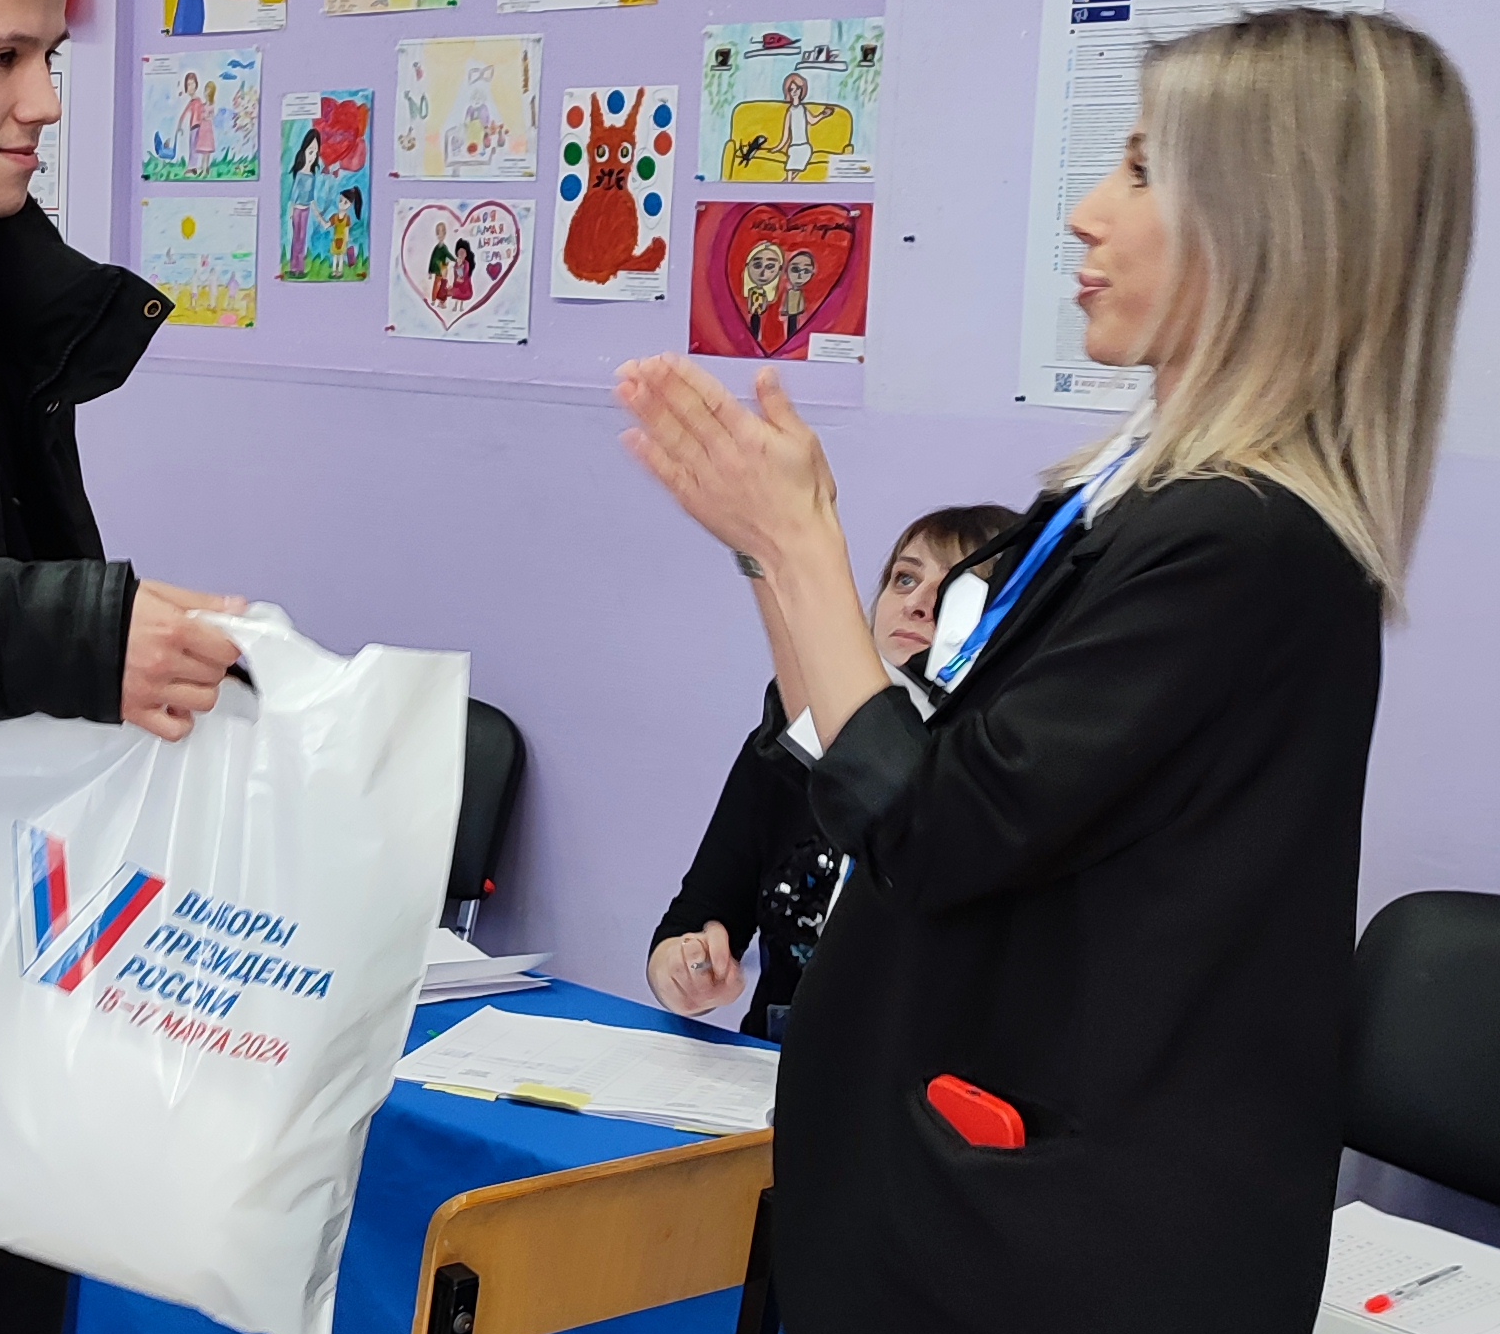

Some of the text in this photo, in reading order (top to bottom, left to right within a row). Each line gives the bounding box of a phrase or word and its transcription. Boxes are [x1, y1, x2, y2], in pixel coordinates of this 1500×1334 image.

[172, 888, 299, 949] ВЫБОРЫ
[114, 953, 243, 1020] РОССИИ
[143, 923, 336, 1001] ПРЕЗИДЕНТА
[152, 1009, 233, 1055] МАРТА
[228, 1030, 290, 1067] 2024
